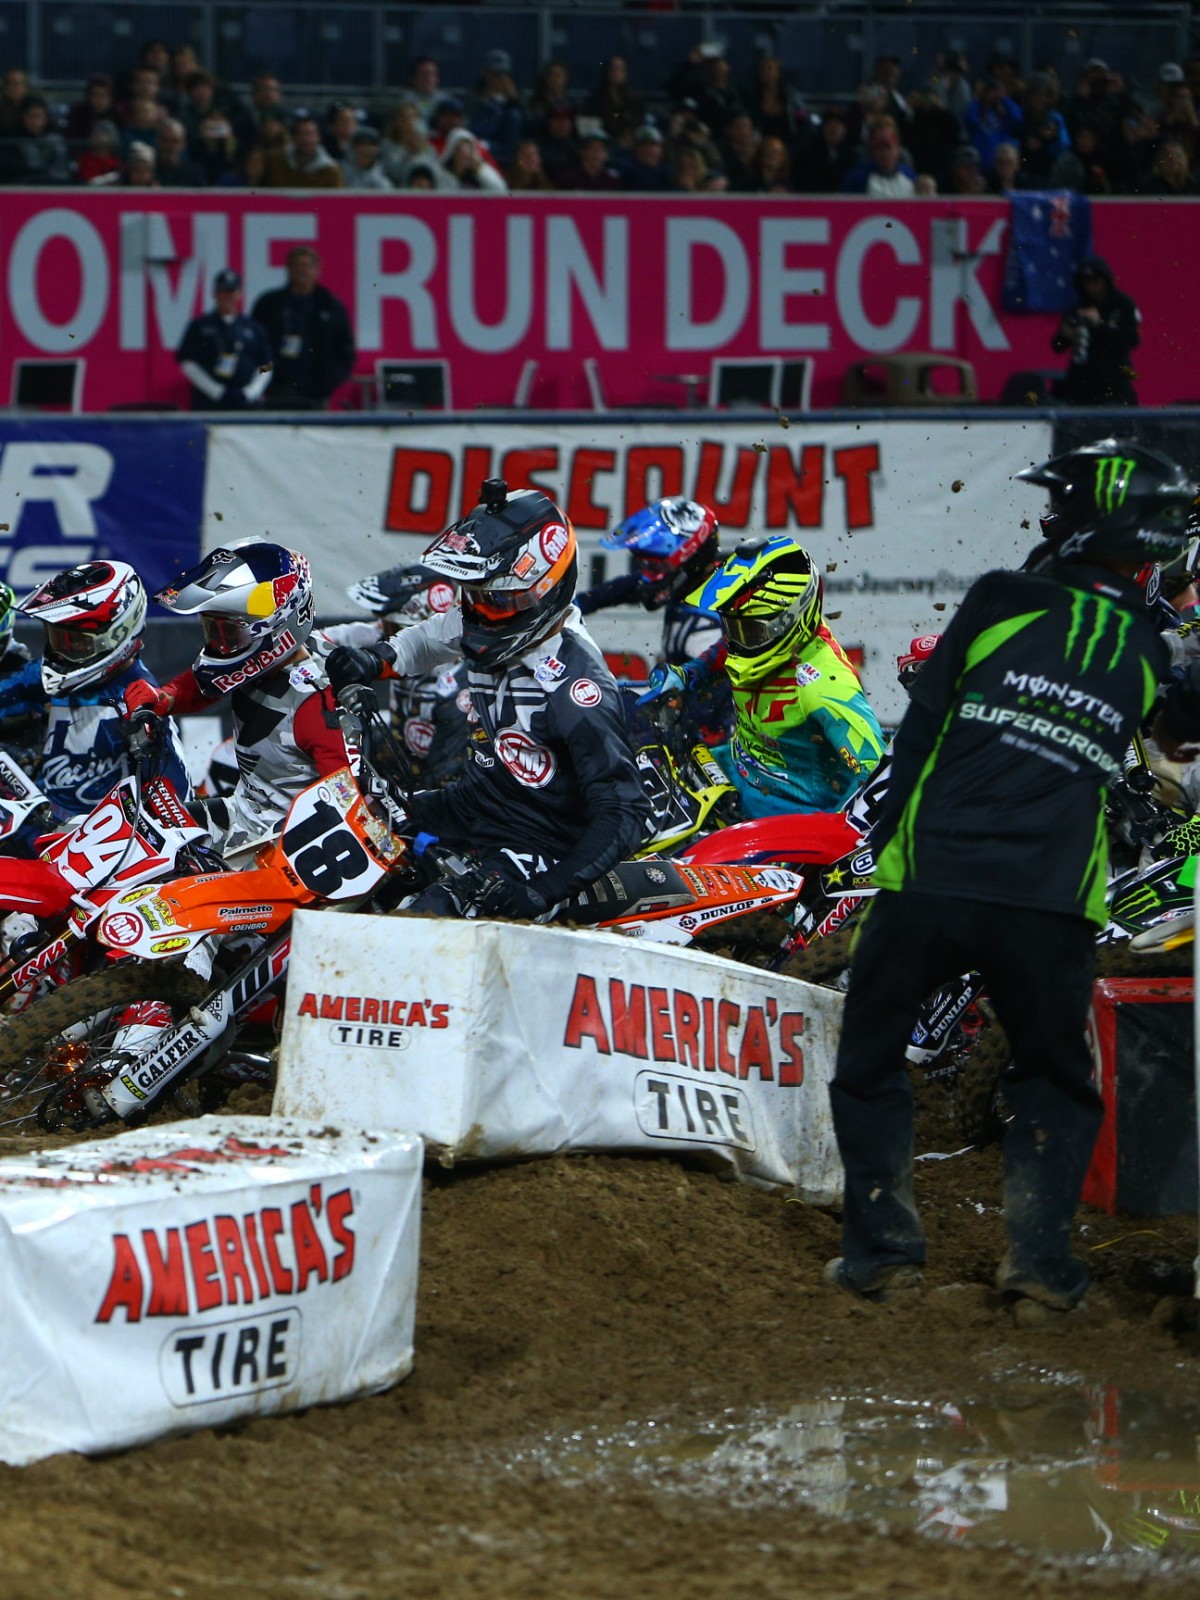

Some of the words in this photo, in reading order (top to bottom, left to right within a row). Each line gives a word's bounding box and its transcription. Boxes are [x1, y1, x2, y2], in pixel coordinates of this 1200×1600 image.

[354, 214, 629, 353] RUN
[665, 215, 1011, 353] DECK
[384, 442, 883, 533] DISCOUNT
[211, 658, 260, 694] Red
[258, 628, 297, 672] Bull
[539, 655, 567, 677] AMA
[67, 802, 150, 887] 94
[281, 799, 370, 897] 18
[281, 866, 300, 888] KTM
[218, 905, 274, 916] Palmetto
[699, 899, 755, 921] DUNLOP
[150, 937, 191, 954] FMF
[297, 992, 450, 1029] AMERICA'S
[338, 1025, 402, 1048] TIRE
[563, 973, 804, 1088] AMERICA'S
[931, 985, 974, 1040] DUNLOP
[120, 1075, 149, 1101] EXCEL
[137, 1030, 201, 1090] GALFER
[923, 1063, 958, 1081] LFER
[648, 1079, 748, 1139] TIRE
[94, 1183, 357, 1324] AMERICA'S
[174, 1318, 290, 1396] TIRE
